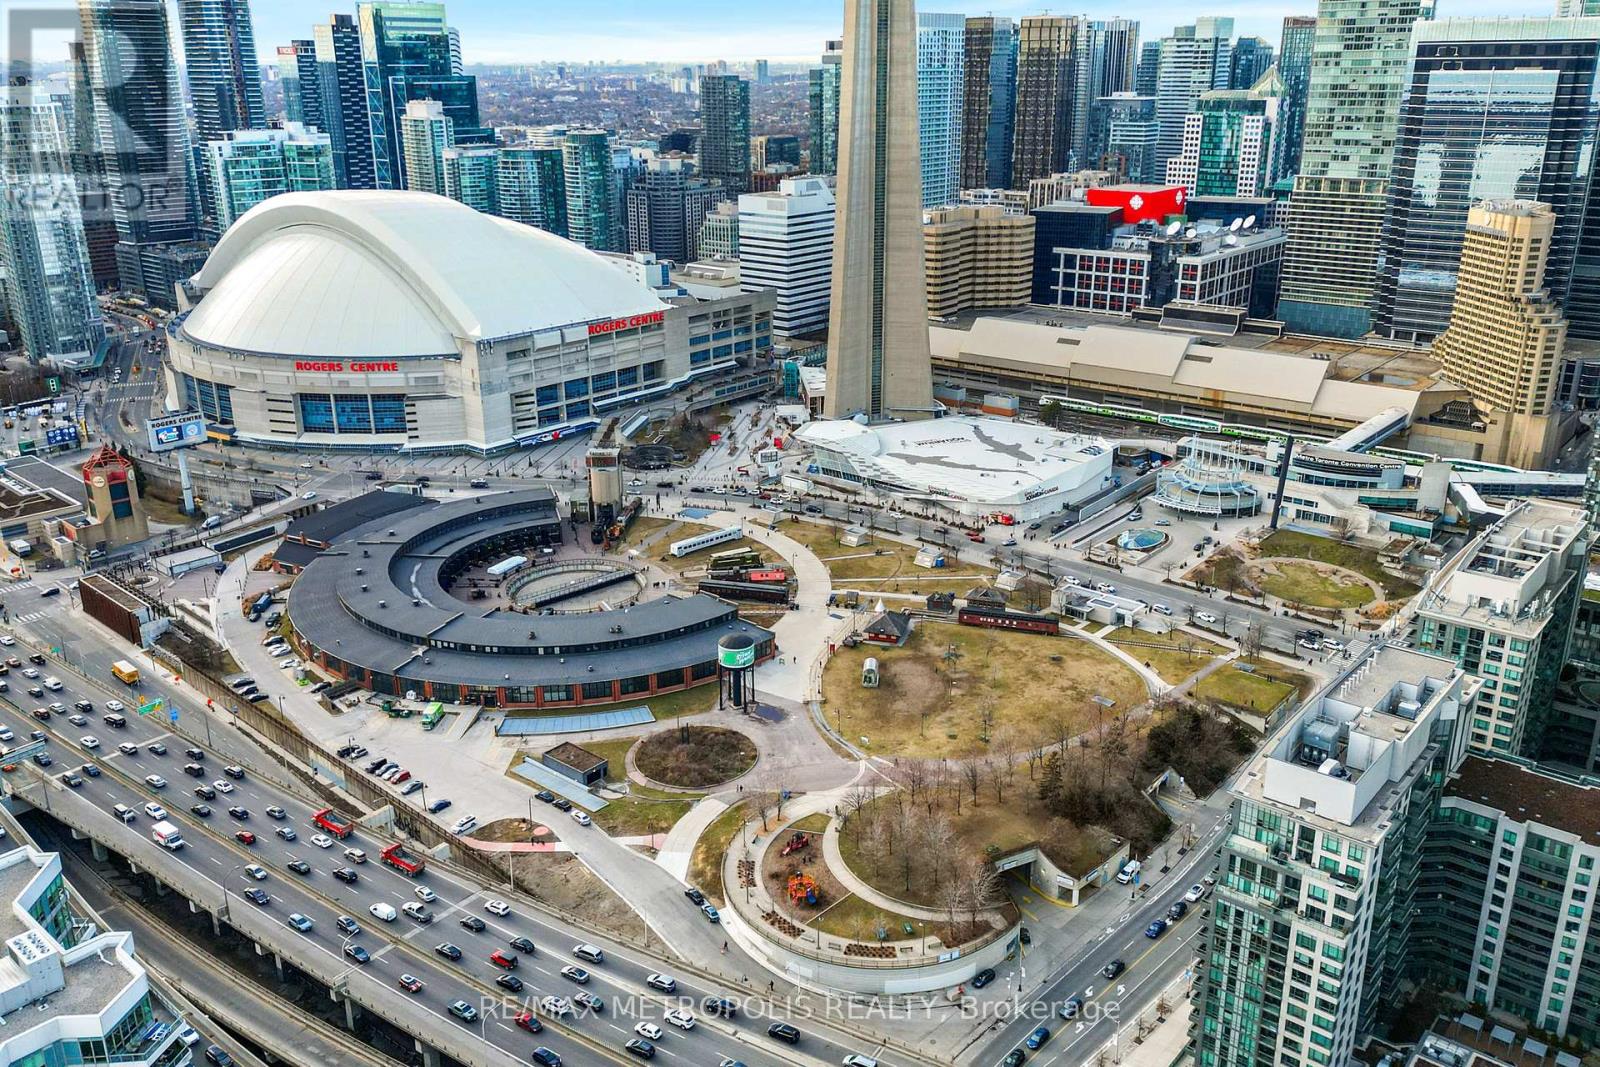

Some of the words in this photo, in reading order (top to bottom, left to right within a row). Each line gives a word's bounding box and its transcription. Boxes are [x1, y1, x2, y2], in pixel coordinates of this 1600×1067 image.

[588, 320, 627, 335] ROGERS
[630, 312, 664, 327] CENTRE
[295, 361, 344, 372] ROGERS
[350, 361, 399, 372] CENTRE
[151, 420, 177, 429] ROGERS
[179, 415, 202, 424] CENTRE
[1340, 461, 1378, 469] Convention
